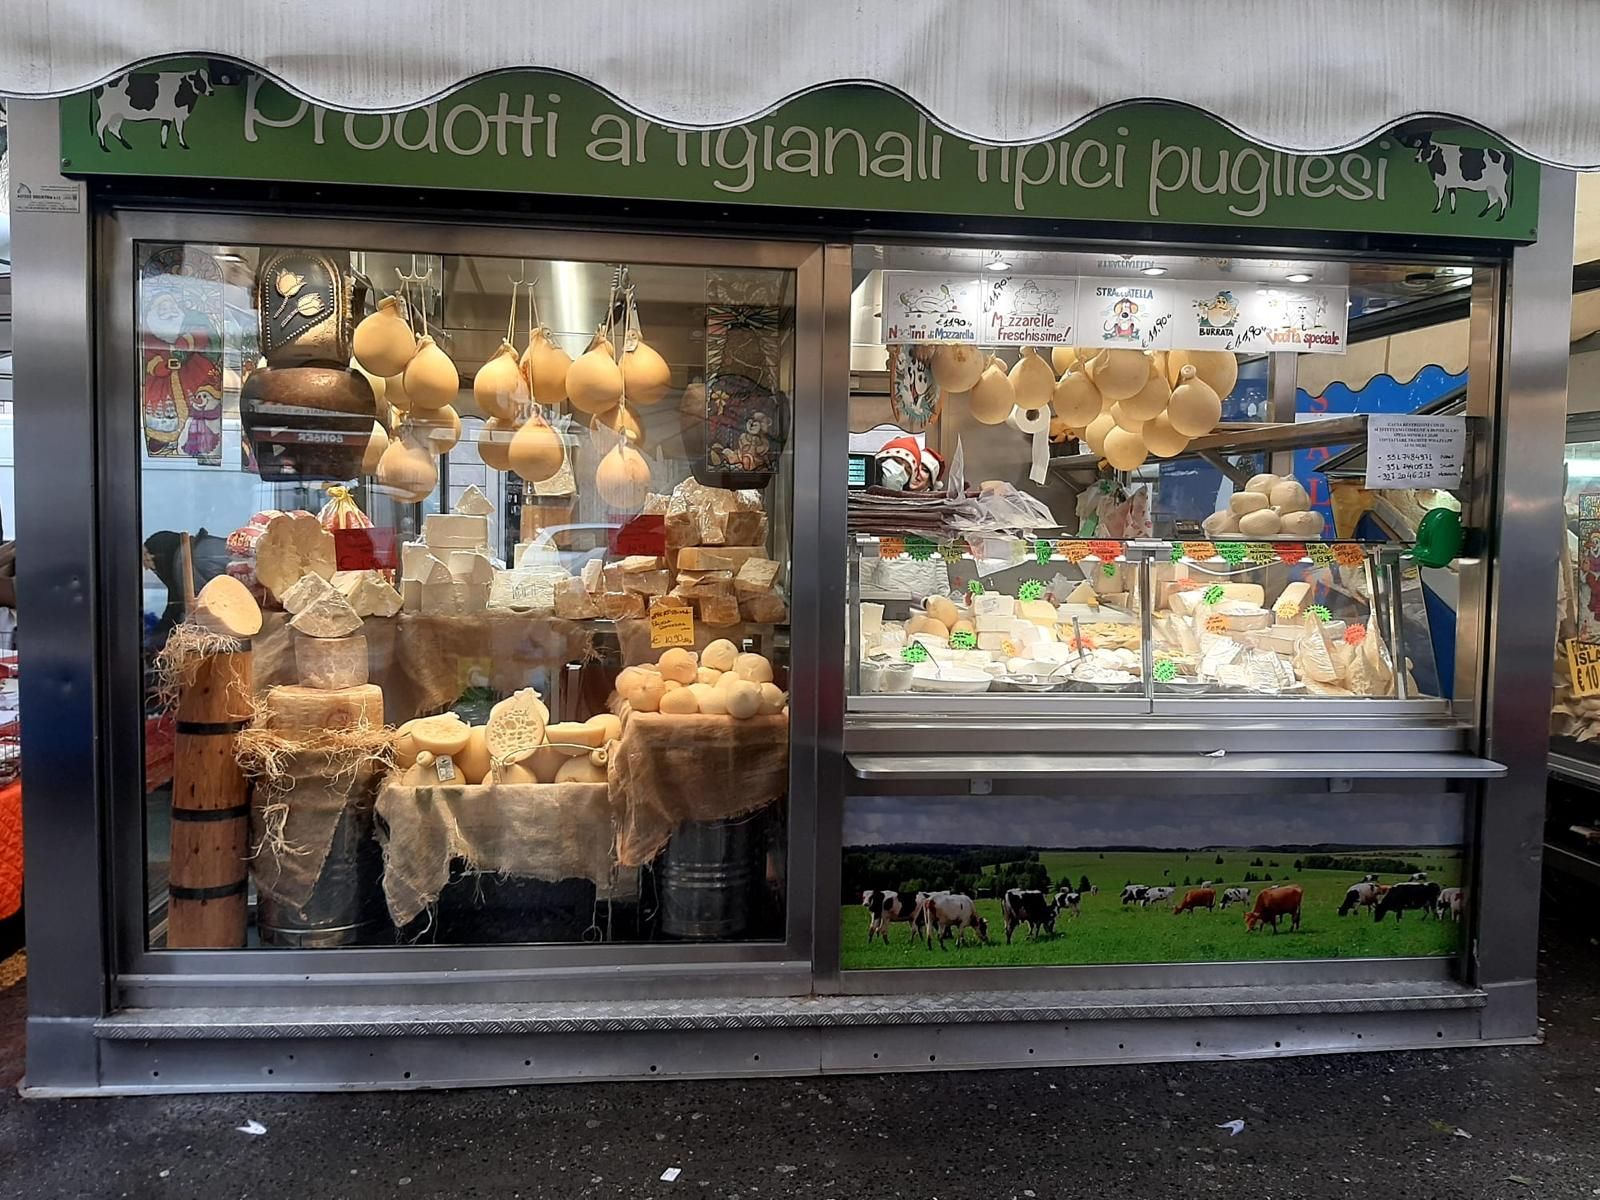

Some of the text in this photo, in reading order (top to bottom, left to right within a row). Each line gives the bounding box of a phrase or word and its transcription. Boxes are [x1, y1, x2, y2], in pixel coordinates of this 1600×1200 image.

[244, 74, 1391, 217] Prodotti artigianali tipici pugliesi
[991, 312, 1055, 327] Mzzarelle
[934, 327, 975, 341] Mozzarella
[998, 326, 1071, 343] Freschissime!
[1199, 328, 1234, 337] BURRATA
[1303, 331, 1340, 349] speciale
[1577, 666, 1586, 692] €
